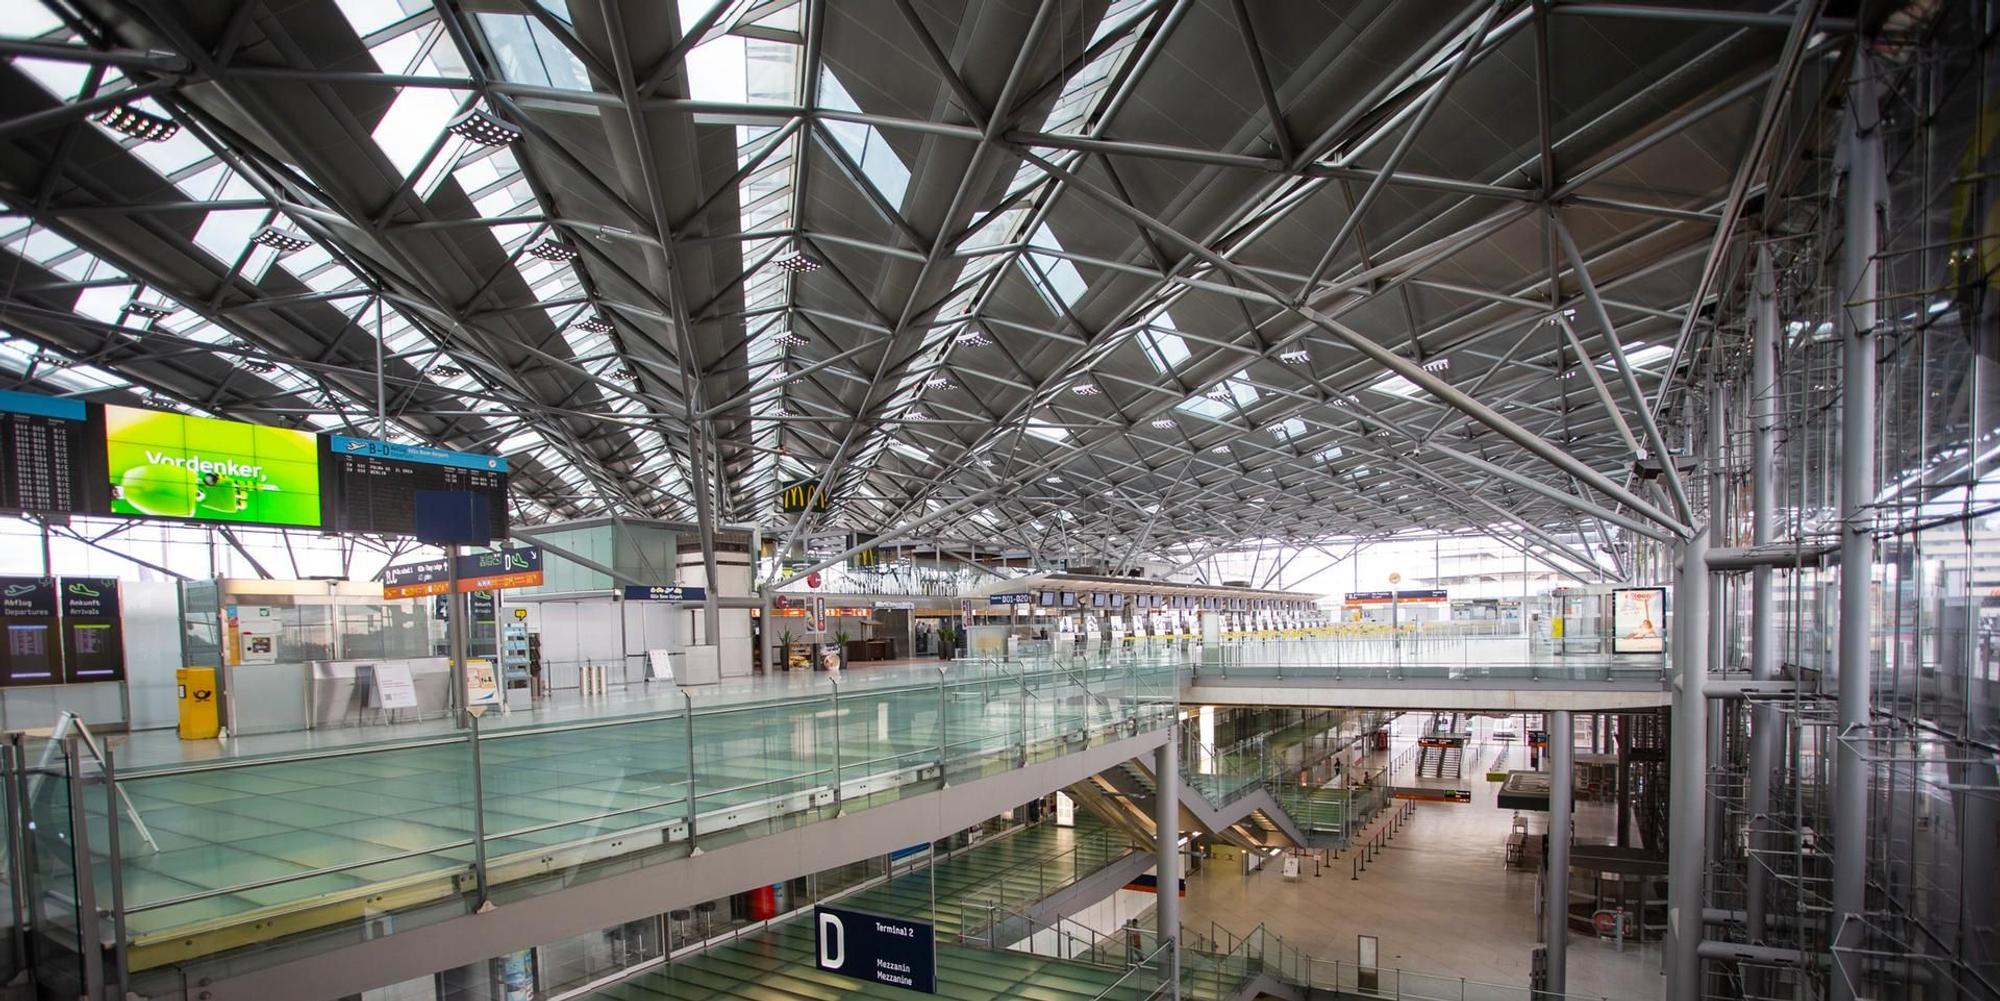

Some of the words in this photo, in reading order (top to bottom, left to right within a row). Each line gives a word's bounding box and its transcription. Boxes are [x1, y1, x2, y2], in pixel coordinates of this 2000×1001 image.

[505, 554, 511, 570] D
[4, 599, 32, 607] Abflug
[875, 922, 907, 936] Terminal
[908, 928, 914, 938] 2
[820, 912, 845, 969] D
[876, 958, 911, 973] Mezzanin
[876, 971, 913, 986] Mezzanine
